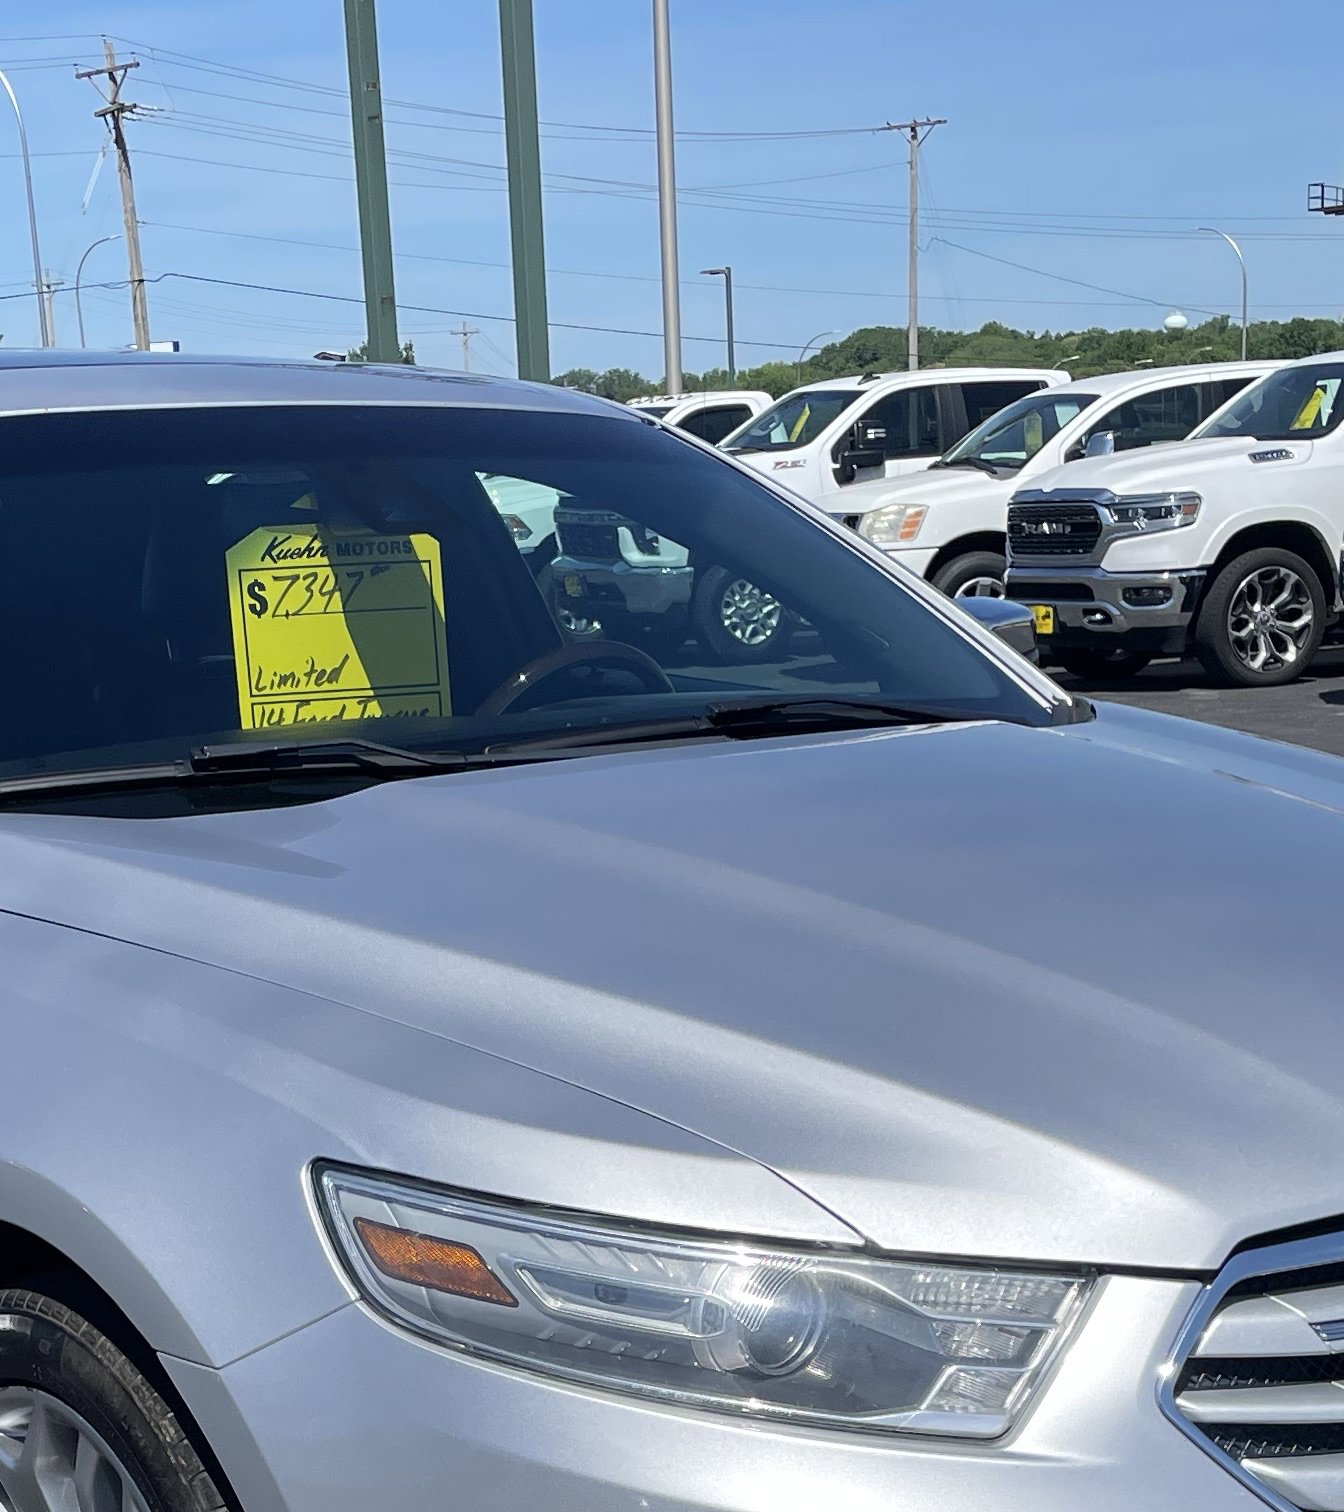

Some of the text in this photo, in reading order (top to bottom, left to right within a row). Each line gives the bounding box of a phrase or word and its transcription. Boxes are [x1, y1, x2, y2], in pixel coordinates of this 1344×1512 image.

[261, 533, 413, 564] Kuehn MOTORS
[254, 653, 350, 693] Limited
